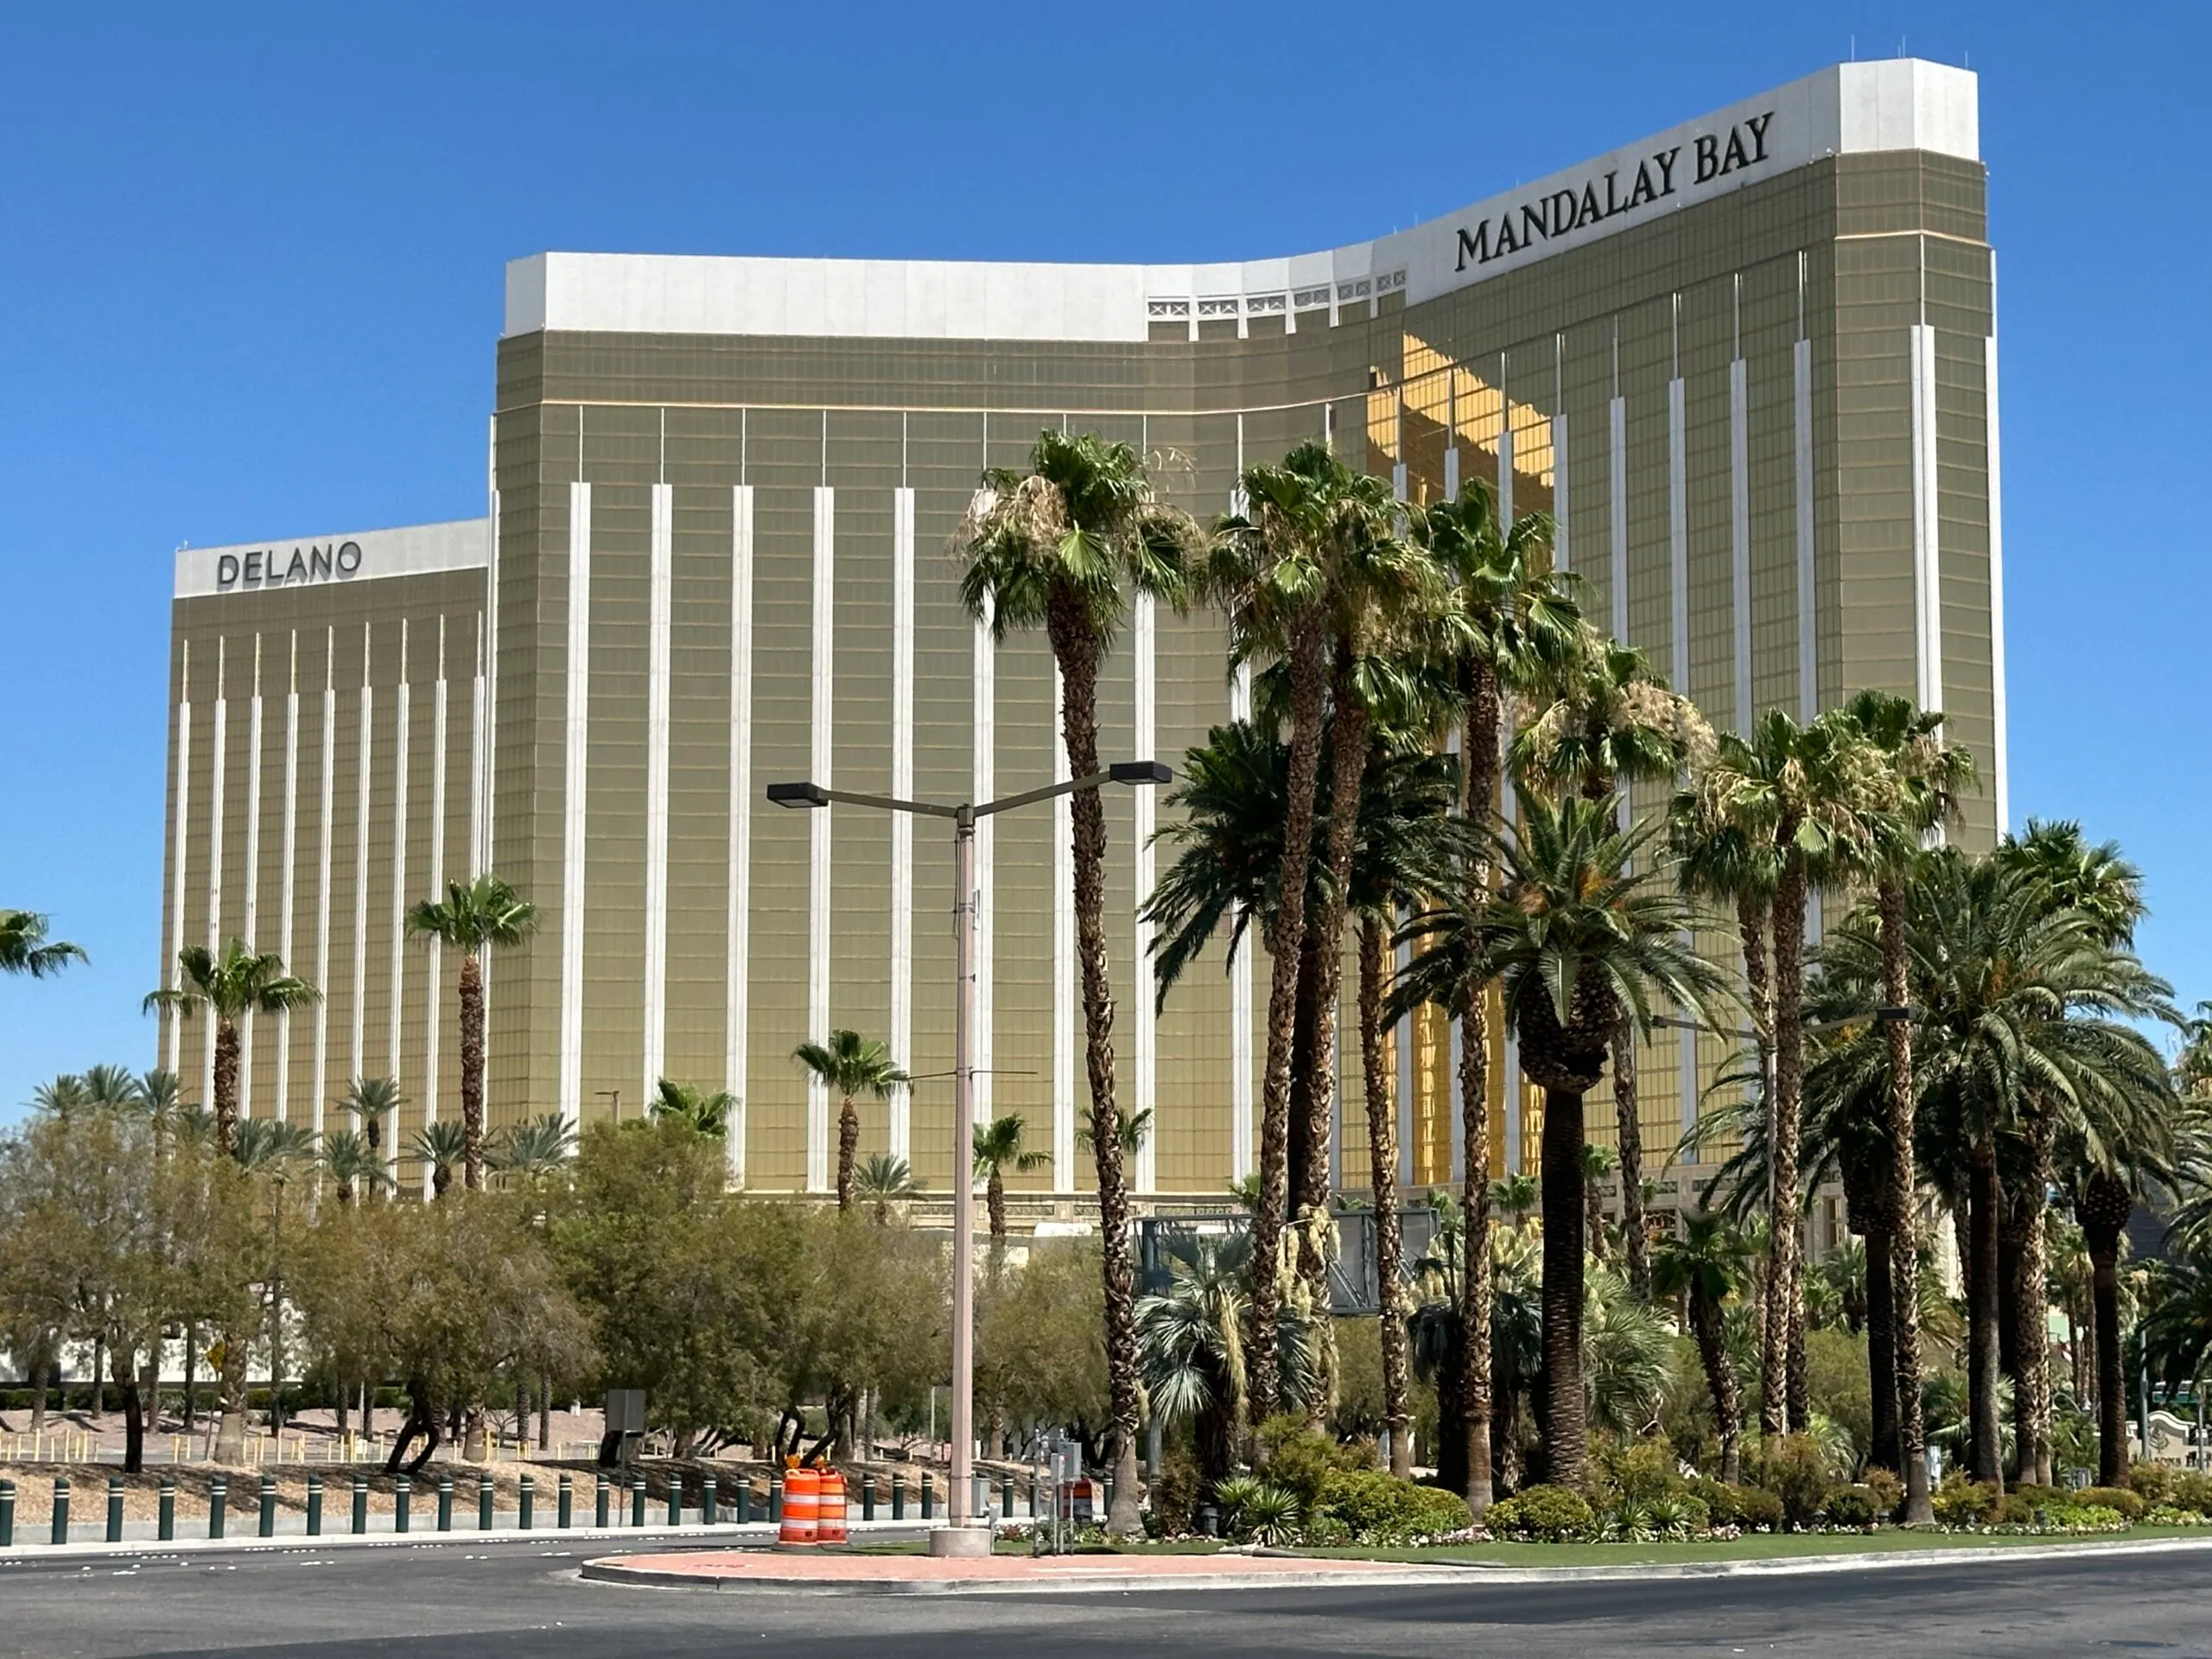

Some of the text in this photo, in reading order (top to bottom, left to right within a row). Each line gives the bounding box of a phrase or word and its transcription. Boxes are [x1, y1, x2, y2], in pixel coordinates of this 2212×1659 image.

[1454, 111, 1775, 272] MANDALAY BAY
[218, 541, 362, 586] DELANO
